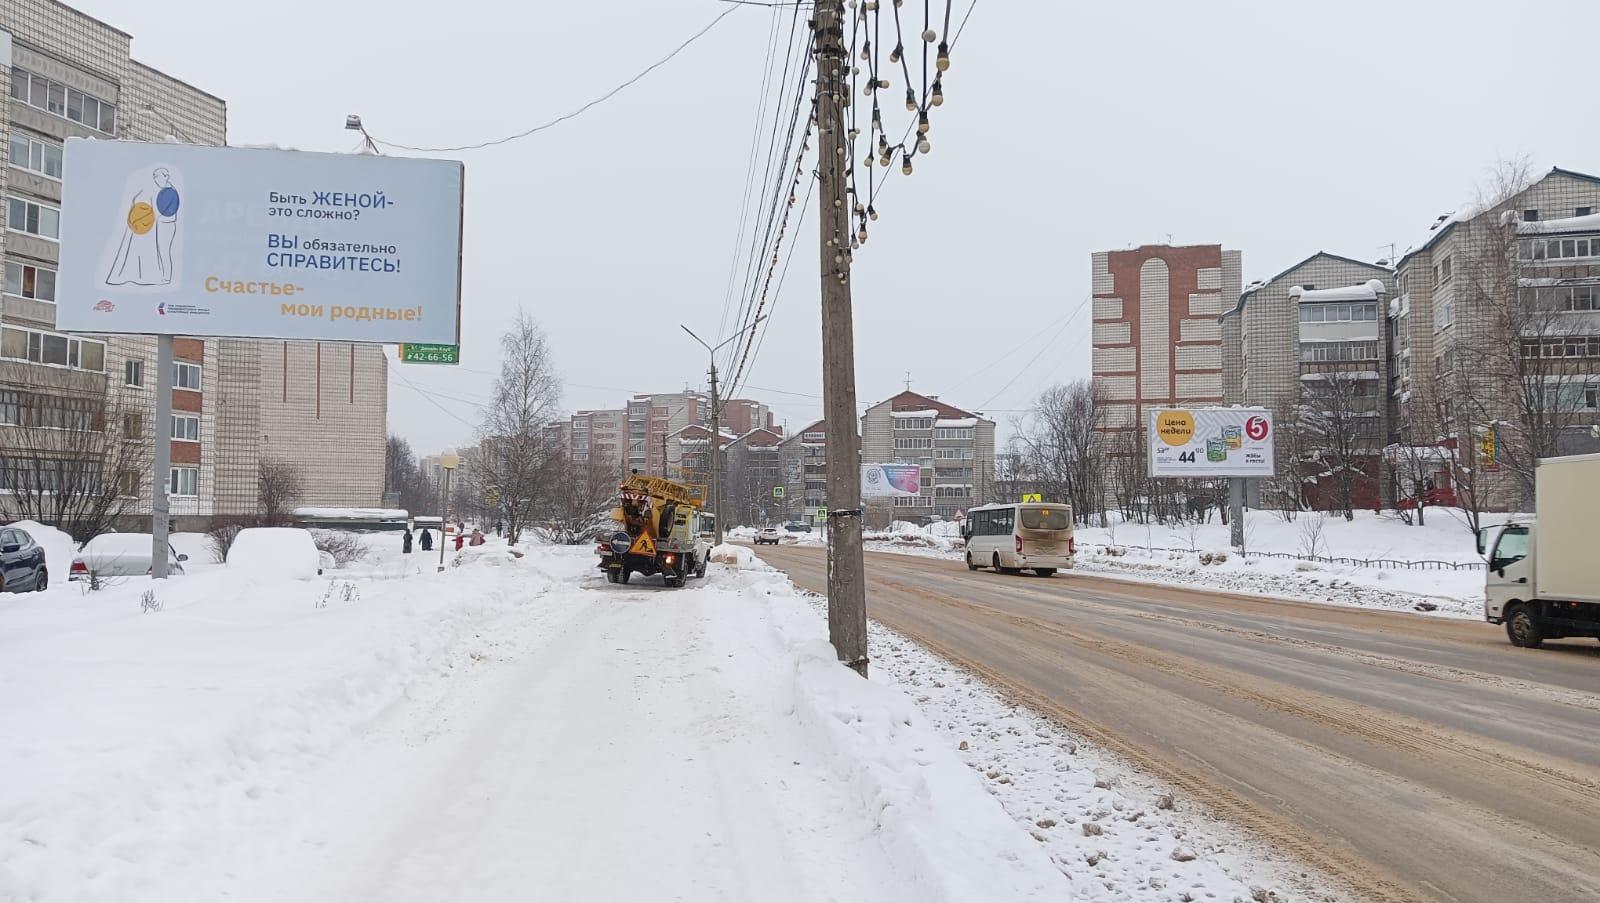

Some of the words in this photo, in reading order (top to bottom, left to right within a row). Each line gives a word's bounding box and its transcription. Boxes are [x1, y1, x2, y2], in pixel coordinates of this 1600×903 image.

[269, 191, 307, 205] Быть
[312, 190, 394, 209] ЖЕНОЙ-
[268, 207, 293, 217] это
[296, 208, 361, 221] сложно?
[268, 233, 298, 249] ВЫ
[302, 239, 397, 255] обязательно
[266, 252, 401, 273] СПРАВИТЕСЬ!
[204, 276, 304, 296] Счастье-
[280, 303, 324, 317] мои
[330, 304, 423, 322] родные!
[413, 352, 453, 362] 42-66-56
[1160, 426, 1191, 435] недели
[1178, 451, 1195, 463] 44
